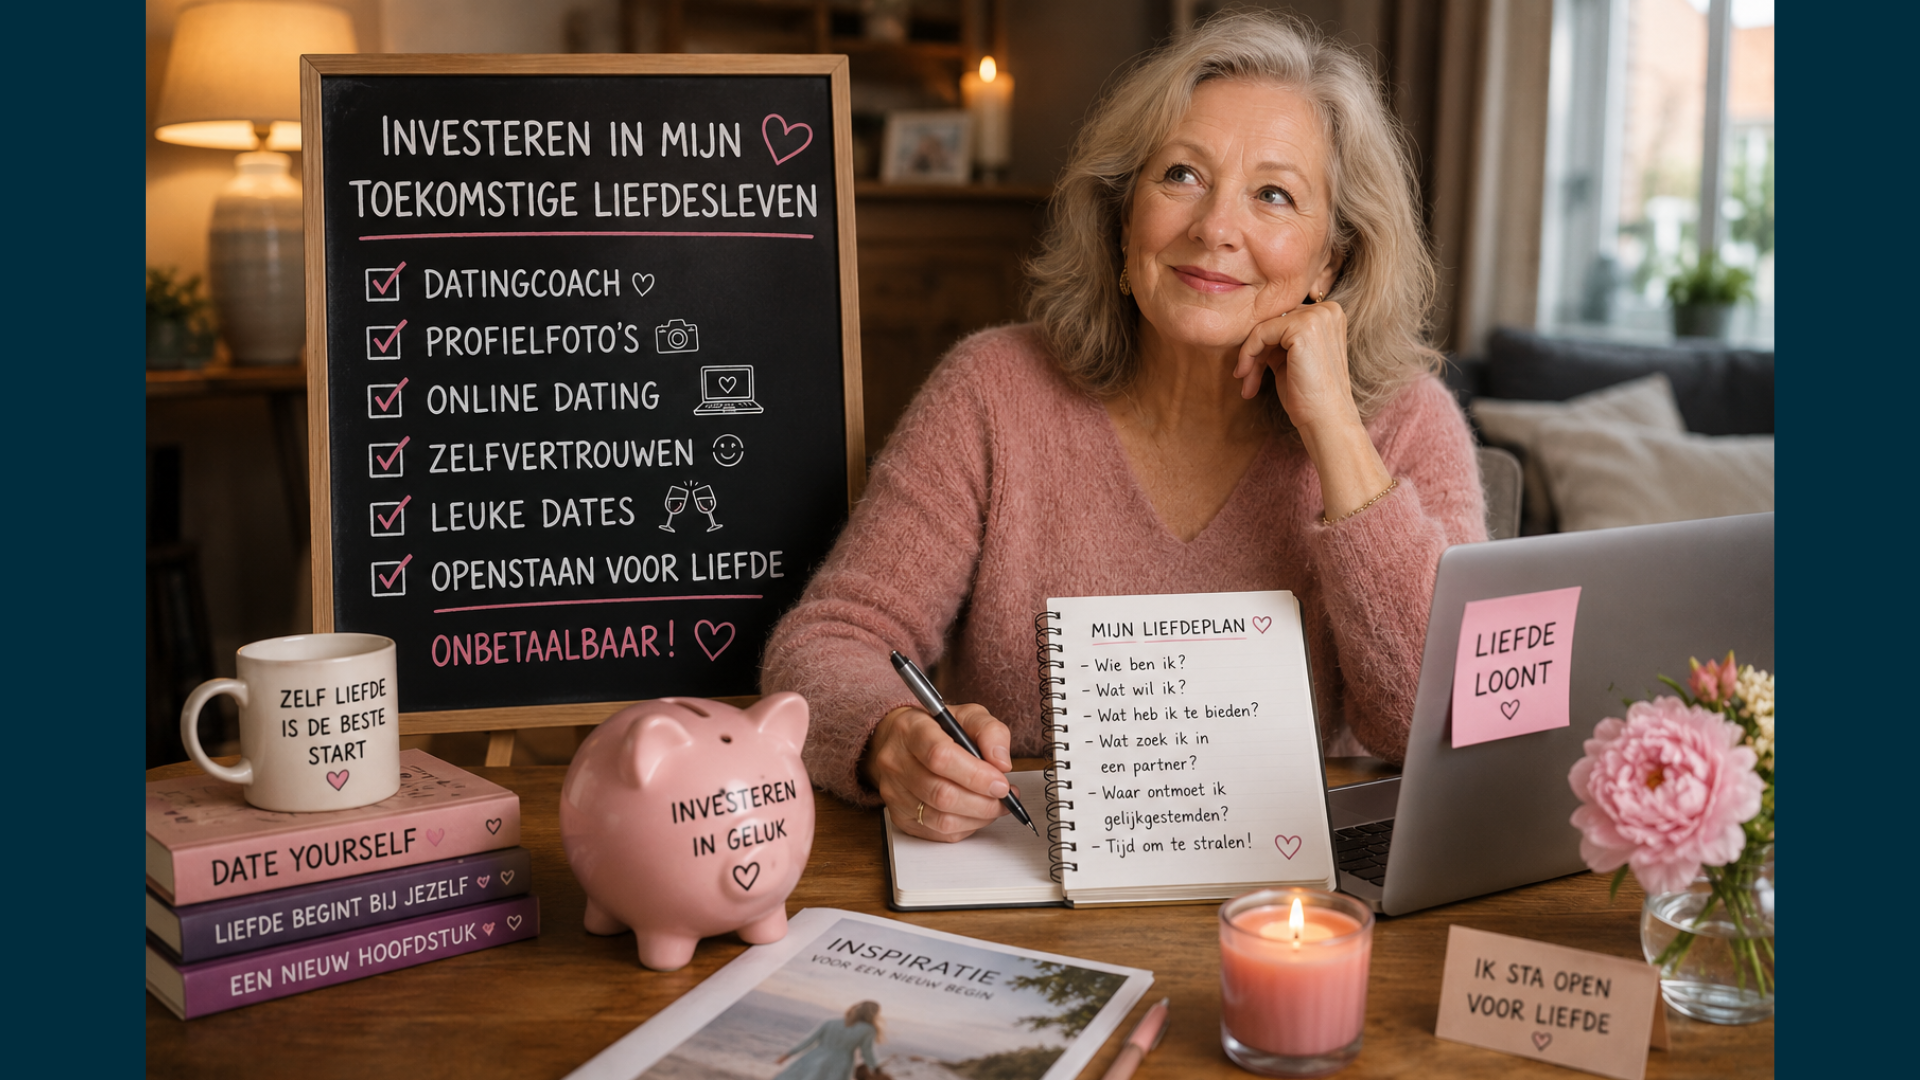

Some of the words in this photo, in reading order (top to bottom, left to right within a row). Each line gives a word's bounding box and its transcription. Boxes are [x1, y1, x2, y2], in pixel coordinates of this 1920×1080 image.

[382, 115, 590, 157] INVESTEREN
[610, 121, 643, 157] IN
[661, 121, 741, 158] MIJN
[349, 180, 578, 218] TOEKOMSTIGE
[594, 181, 817, 218] LIEFDESLEVEN
[424, 268, 620, 299] DATINGCOACH
[427, 323, 639, 357] PROFIELFOTO'S
[427, 383, 537, 415] ONLINE
[555, 381, 660, 411] DATING
[428, 439, 694, 474] ZELFVERTROUWEN
[431, 500, 525, 533] LEUKE
[542, 497, 635, 527] DATES
[431, 556, 594, 592] OPENSTAAN
[605, 553, 679, 584] VOOR
[692, 550, 784, 582] LIEFDE
[1091, 622, 1133, 638] MIJN
[1143, 618, 1246, 636] LIEFDEPLAN
[1475, 621, 1556, 658] LIEFDE
[1095, 658, 1122, 672] Wie
[1130, 656, 1155, 671] ben
[1163, 654, 1186, 670] ik?
[1475, 660, 1553, 697] LOONT
[280, 688, 326, 708] ZELF
[336, 678, 386, 705] LIEFDE
[1096, 683, 1125, 697] Wat
[1132, 682, 1154, 696] wil
[1163, 679, 1186, 695] ik?
[281, 719, 298, 738] IS
[308, 717, 331, 737] DE
[340, 707, 386, 733] BESTE
[1098, 708, 1127, 722] Wat
[1134, 707, 1158, 721] heb
[1165, 706, 1178, 720] ik
[1184, 706, 1199, 719] te
[1205, 701, 1259, 719] bieden?
[308, 740, 367, 765] START
[1099, 734, 1129, 748] Wat
[1136, 732, 1168, 747] zoek
[1175, 731, 1188, 746] ik
[1196, 732, 1209, 745] in
[1100, 761, 1126, 773] een
[1133, 755, 1197, 777] partner?
[671, 779, 797, 825] INVESTEREN
[1102, 785, 1140, 800] Waar
[1147, 783, 1206, 798] ontmoet
[1213, 782, 1227, 796] ik
[1104, 805, 1229, 831] gelijkgestemden?
[692, 834, 715, 858] IN
[727, 819, 788, 851] GELUK
[1106, 837, 1135, 858] Tijd
[1143, 839, 1163, 852] om
[1170, 836, 1186, 851] te
[1194, 832, 1252, 850] stralen!
[212, 851, 278, 886] DATE
[289, 827, 417, 872] YOURSELF
[215, 911, 284, 944] LIEFDE
[292, 897, 363, 929] BEGINT
[369, 889, 398, 914] BIJ
[404, 876, 469, 906] JEZELF
[230, 968, 272, 997] EEN
[281, 951, 349, 986] NIEUW
[359, 922, 477, 968] HOOFDSTUK
[827, 937, 1002, 986] INSPIRATIE
[811, 954, 851, 970] VOOR
[854, 964, 886, 977] EEN
[889, 972, 943, 989] NIEUW
[944, 984, 995, 1001] BEGIN
[1474, 957, 1496, 980] IK
[1507, 963, 1544, 989] STA
[1554, 971, 1612, 999] OPEN
[1467, 993, 1525, 1021] VOOR
[1536, 1003, 1611, 1034] LIEFDE
